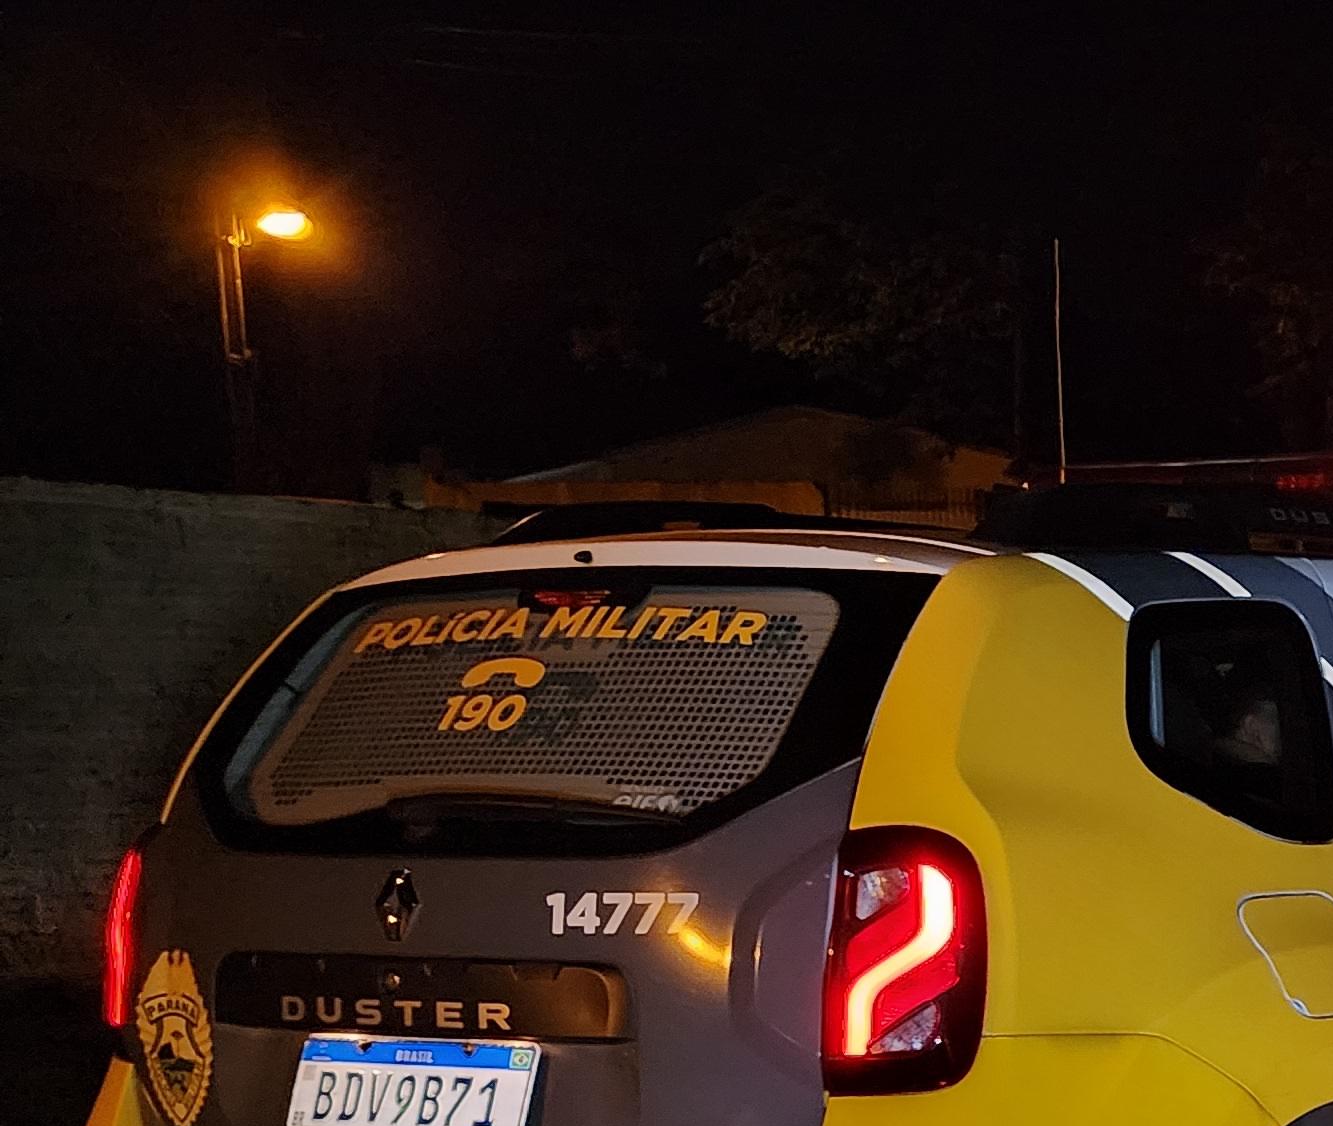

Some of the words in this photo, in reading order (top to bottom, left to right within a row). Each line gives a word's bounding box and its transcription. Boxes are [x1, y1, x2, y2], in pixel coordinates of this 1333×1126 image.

[354, 608, 530, 654] POLÍCIA
[540, 606, 768, 645] MILITAR
[438, 694, 528, 731] 190
[546, 892, 699, 935] 14777
[281, 996, 512, 1030] DUSTER
